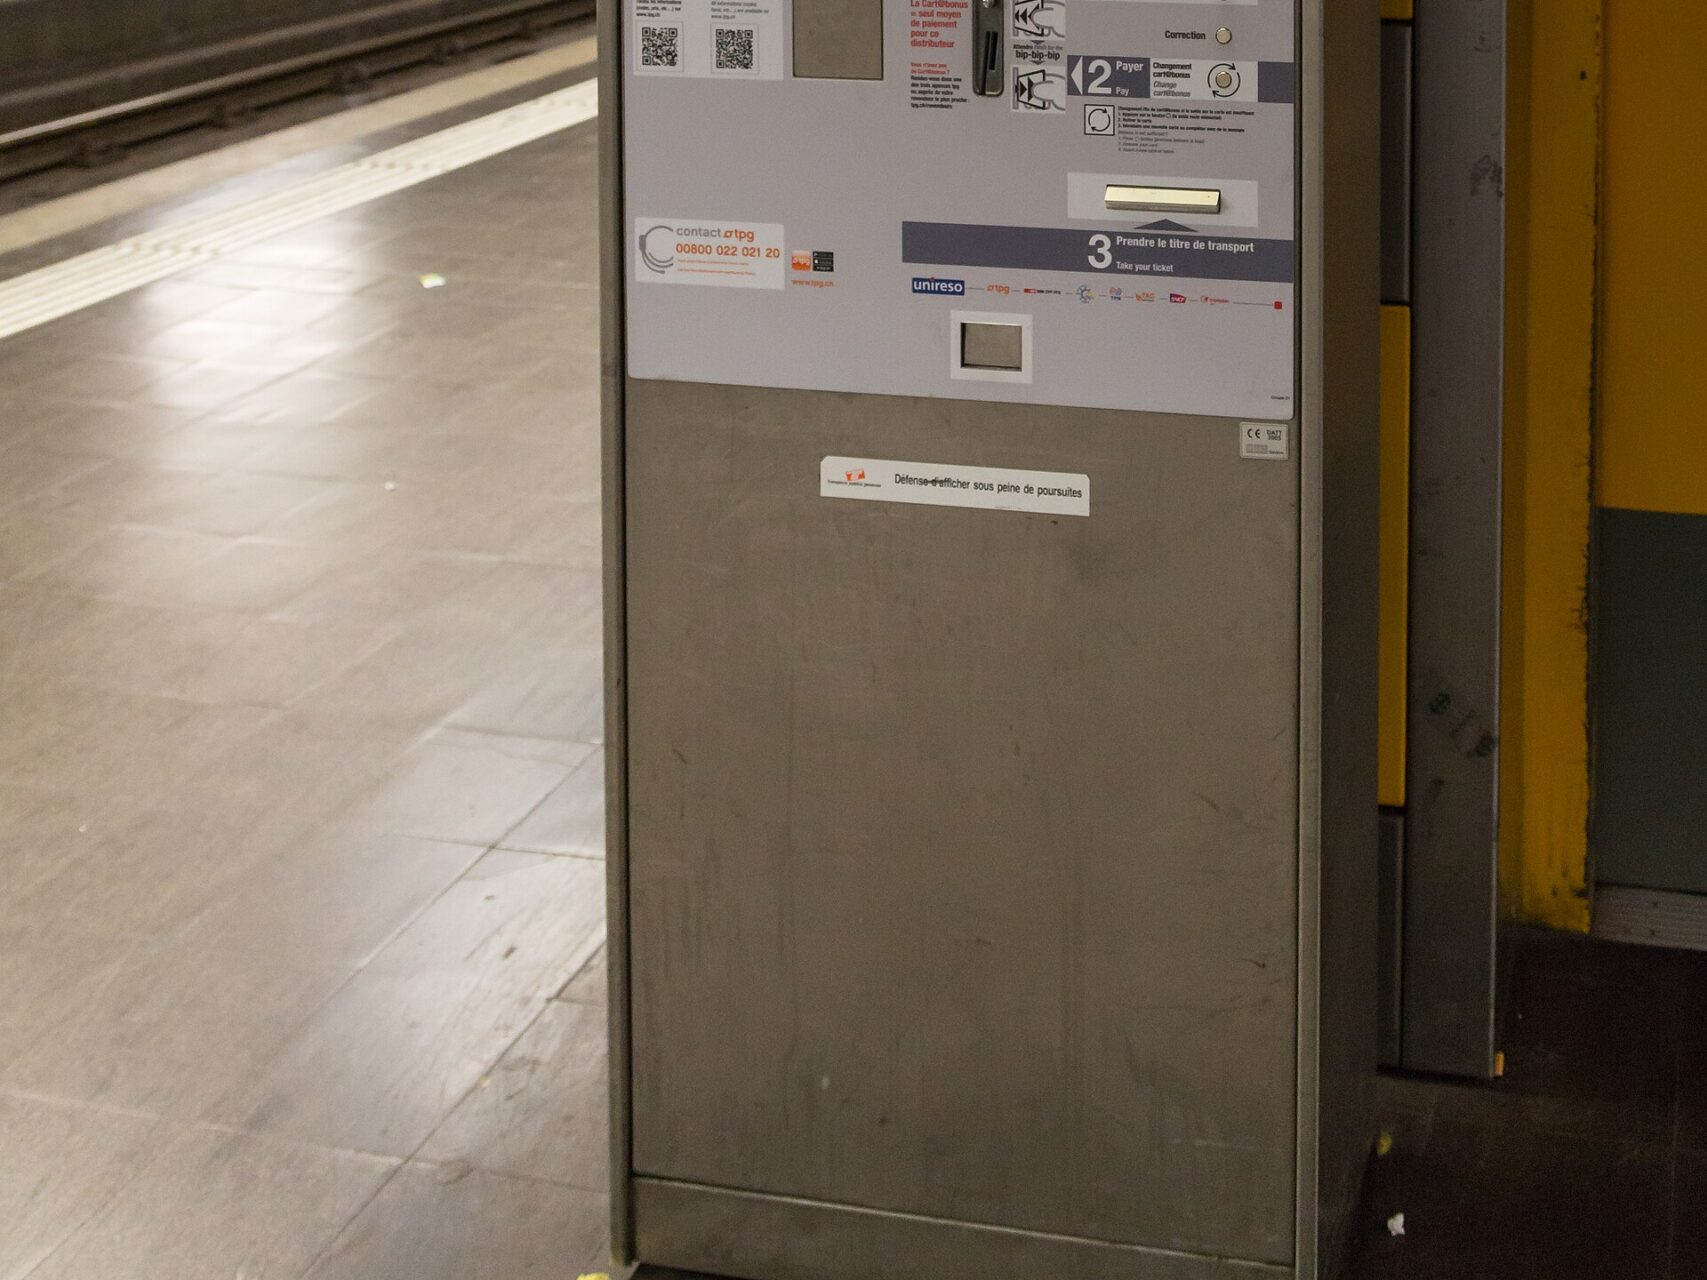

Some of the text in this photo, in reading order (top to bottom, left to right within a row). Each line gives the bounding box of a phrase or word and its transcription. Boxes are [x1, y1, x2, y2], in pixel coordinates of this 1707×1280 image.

[922, 20, 957, 28] paiement
[1165, 31, 1205, 40] Correction
[911, 40, 954, 48] distributeur
[1016, 50, 1060, 61] bip-bip-bip
[1116, 61, 1143, 71] Payer
[1153, 63, 1192, 71] Changement
[1088, 59, 1111, 94] 2
[1154, 81, 1176, 89] Change
[1116, 87, 1129, 96] Pay
[677, 228, 754, 242] contact tpg
[1117, 236, 1254, 253] Prendre le titre de transport
[676, 244, 780, 258] 00800 022 021 20
[1088, 234, 1112, 268] 3
[1117, 261, 1173, 272] Take your ticket
[913, 278, 963, 293] unireso
[973, 481, 994, 491] sous
[997, 482, 1020, 493] peine
[1024, 483, 1034, 494] de
[1037, 486, 1082, 498] poursuites
